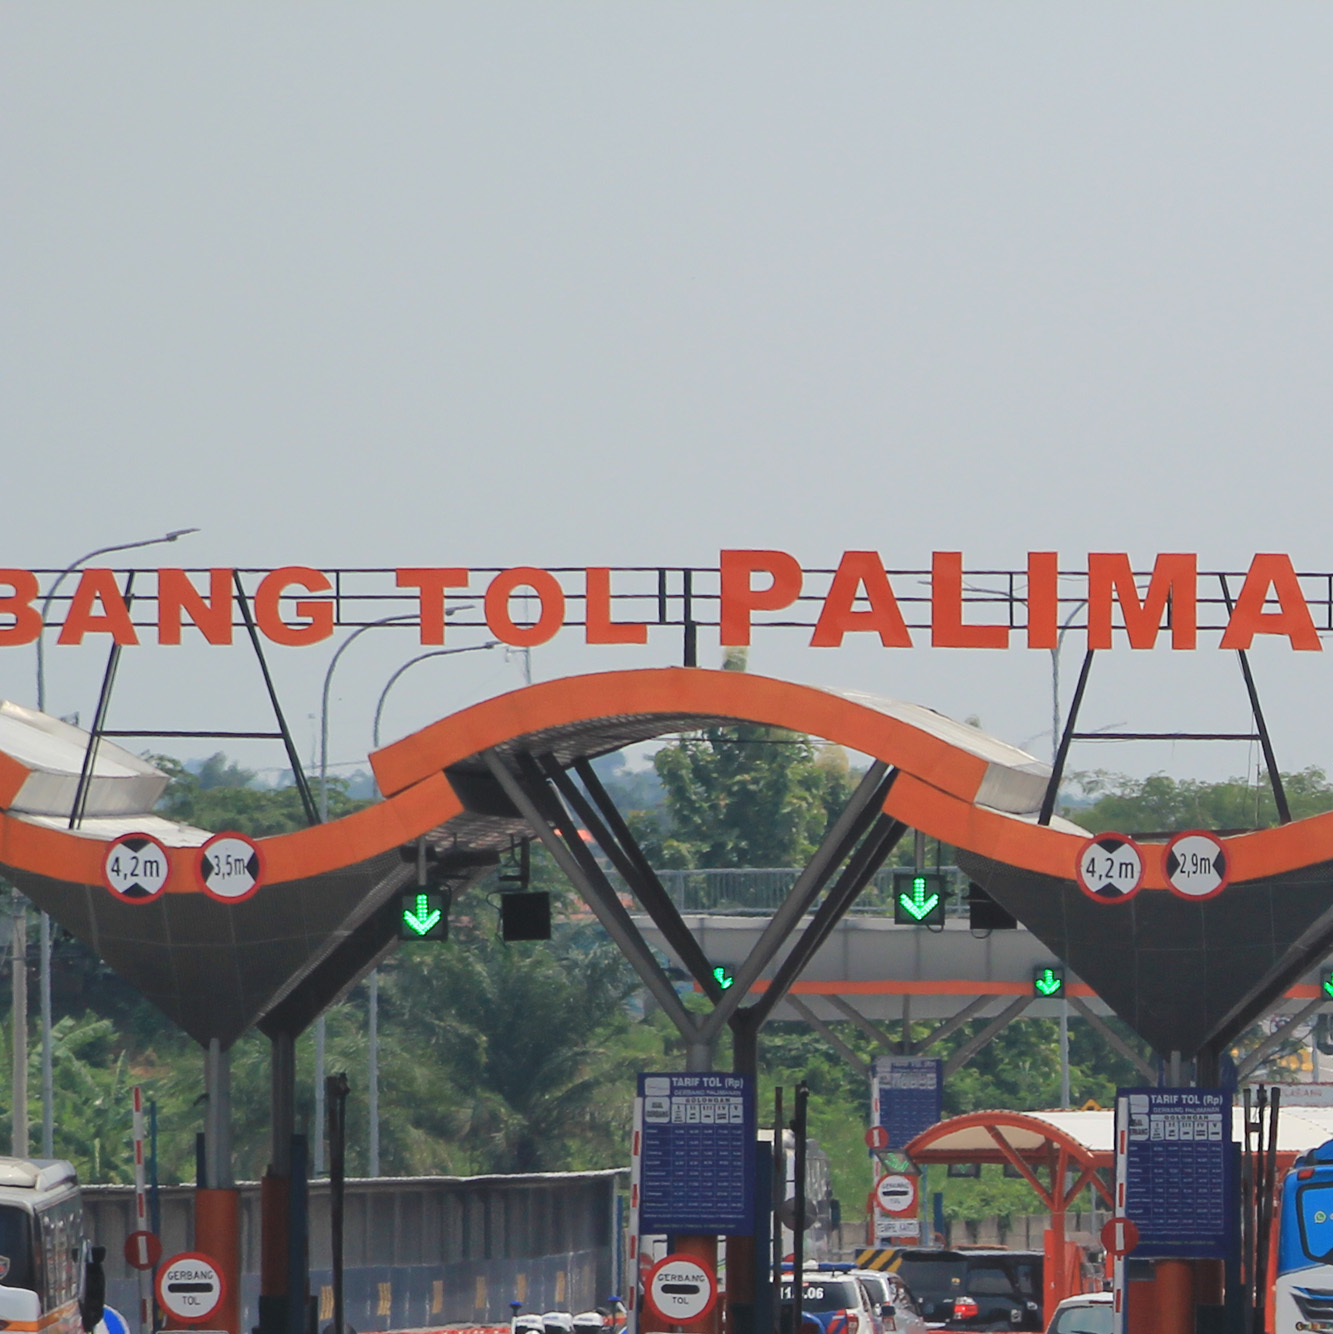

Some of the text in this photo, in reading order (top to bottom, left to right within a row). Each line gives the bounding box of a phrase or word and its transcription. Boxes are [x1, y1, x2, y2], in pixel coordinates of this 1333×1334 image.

[396, 567, 648, 647] TOL
[672, 1078, 744, 1089] TARIF TOL (Rp)
[1150, 1095, 1223, 1105] TARIF TOL (Rp)
[168, 1271, 214, 1281] GERBANG
[658, 1274, 706, 1282] GERBANG
[182, 1296, 201, 1305] TOL
[672, 1296, 689, 1305] TOL
